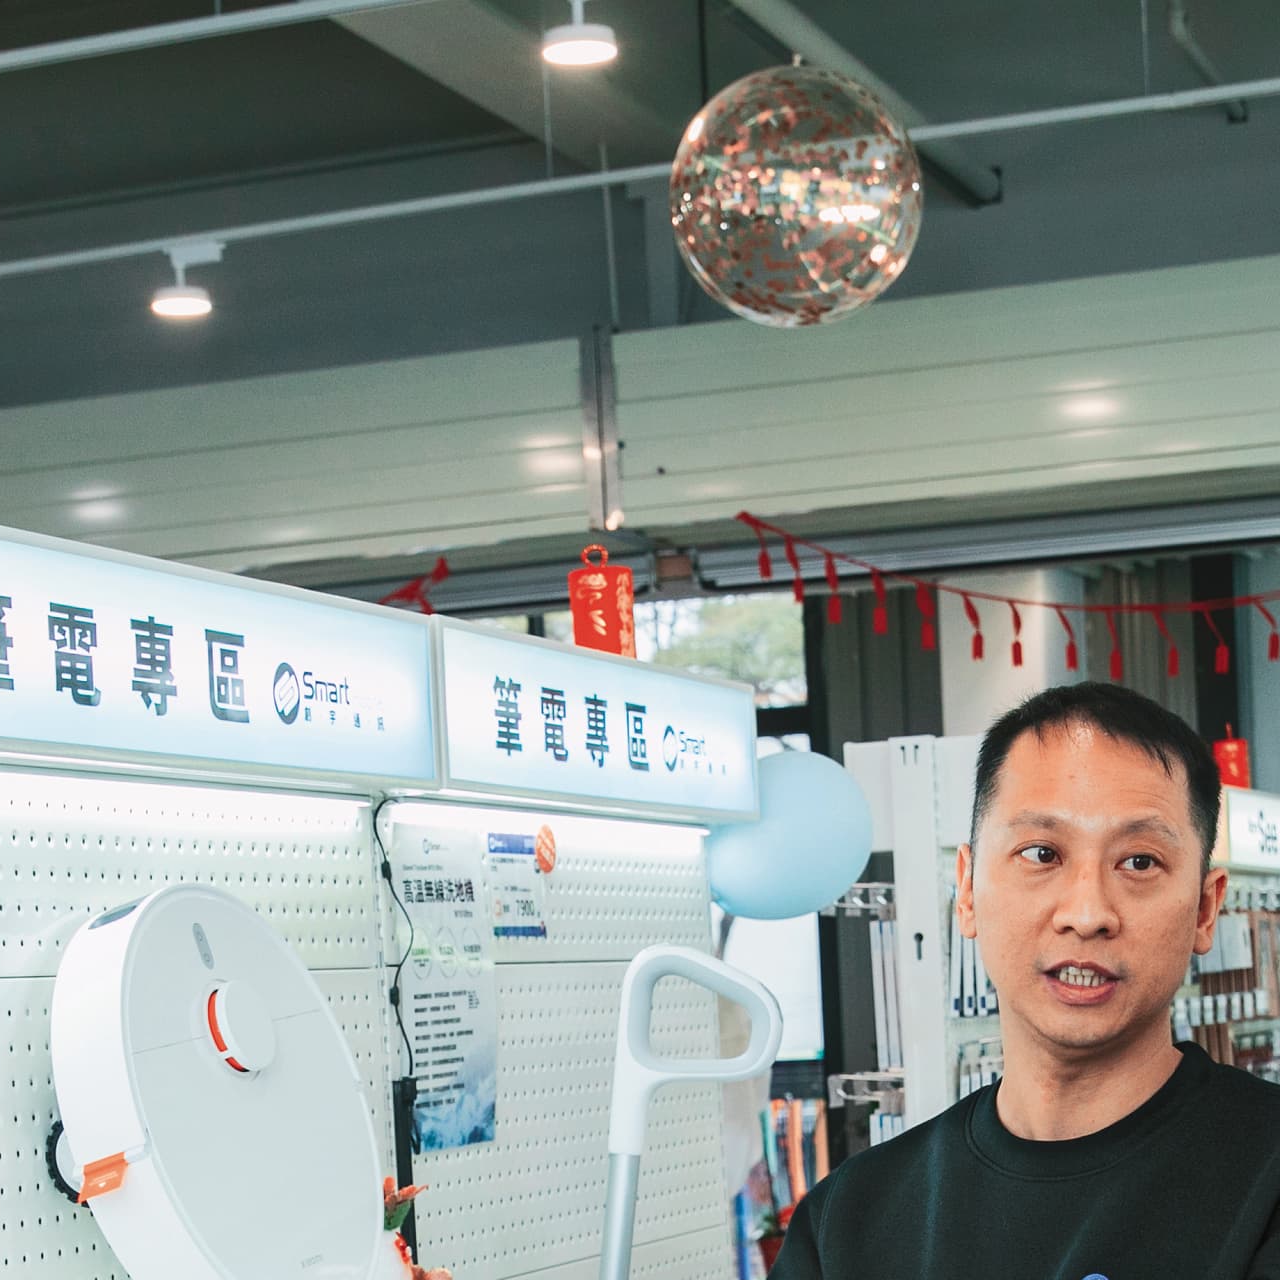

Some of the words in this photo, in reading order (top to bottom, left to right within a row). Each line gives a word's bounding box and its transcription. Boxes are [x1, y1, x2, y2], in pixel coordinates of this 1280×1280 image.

[303, 671, 350, 705] Smart
[492, 675, 650, 772] 筆電專區
